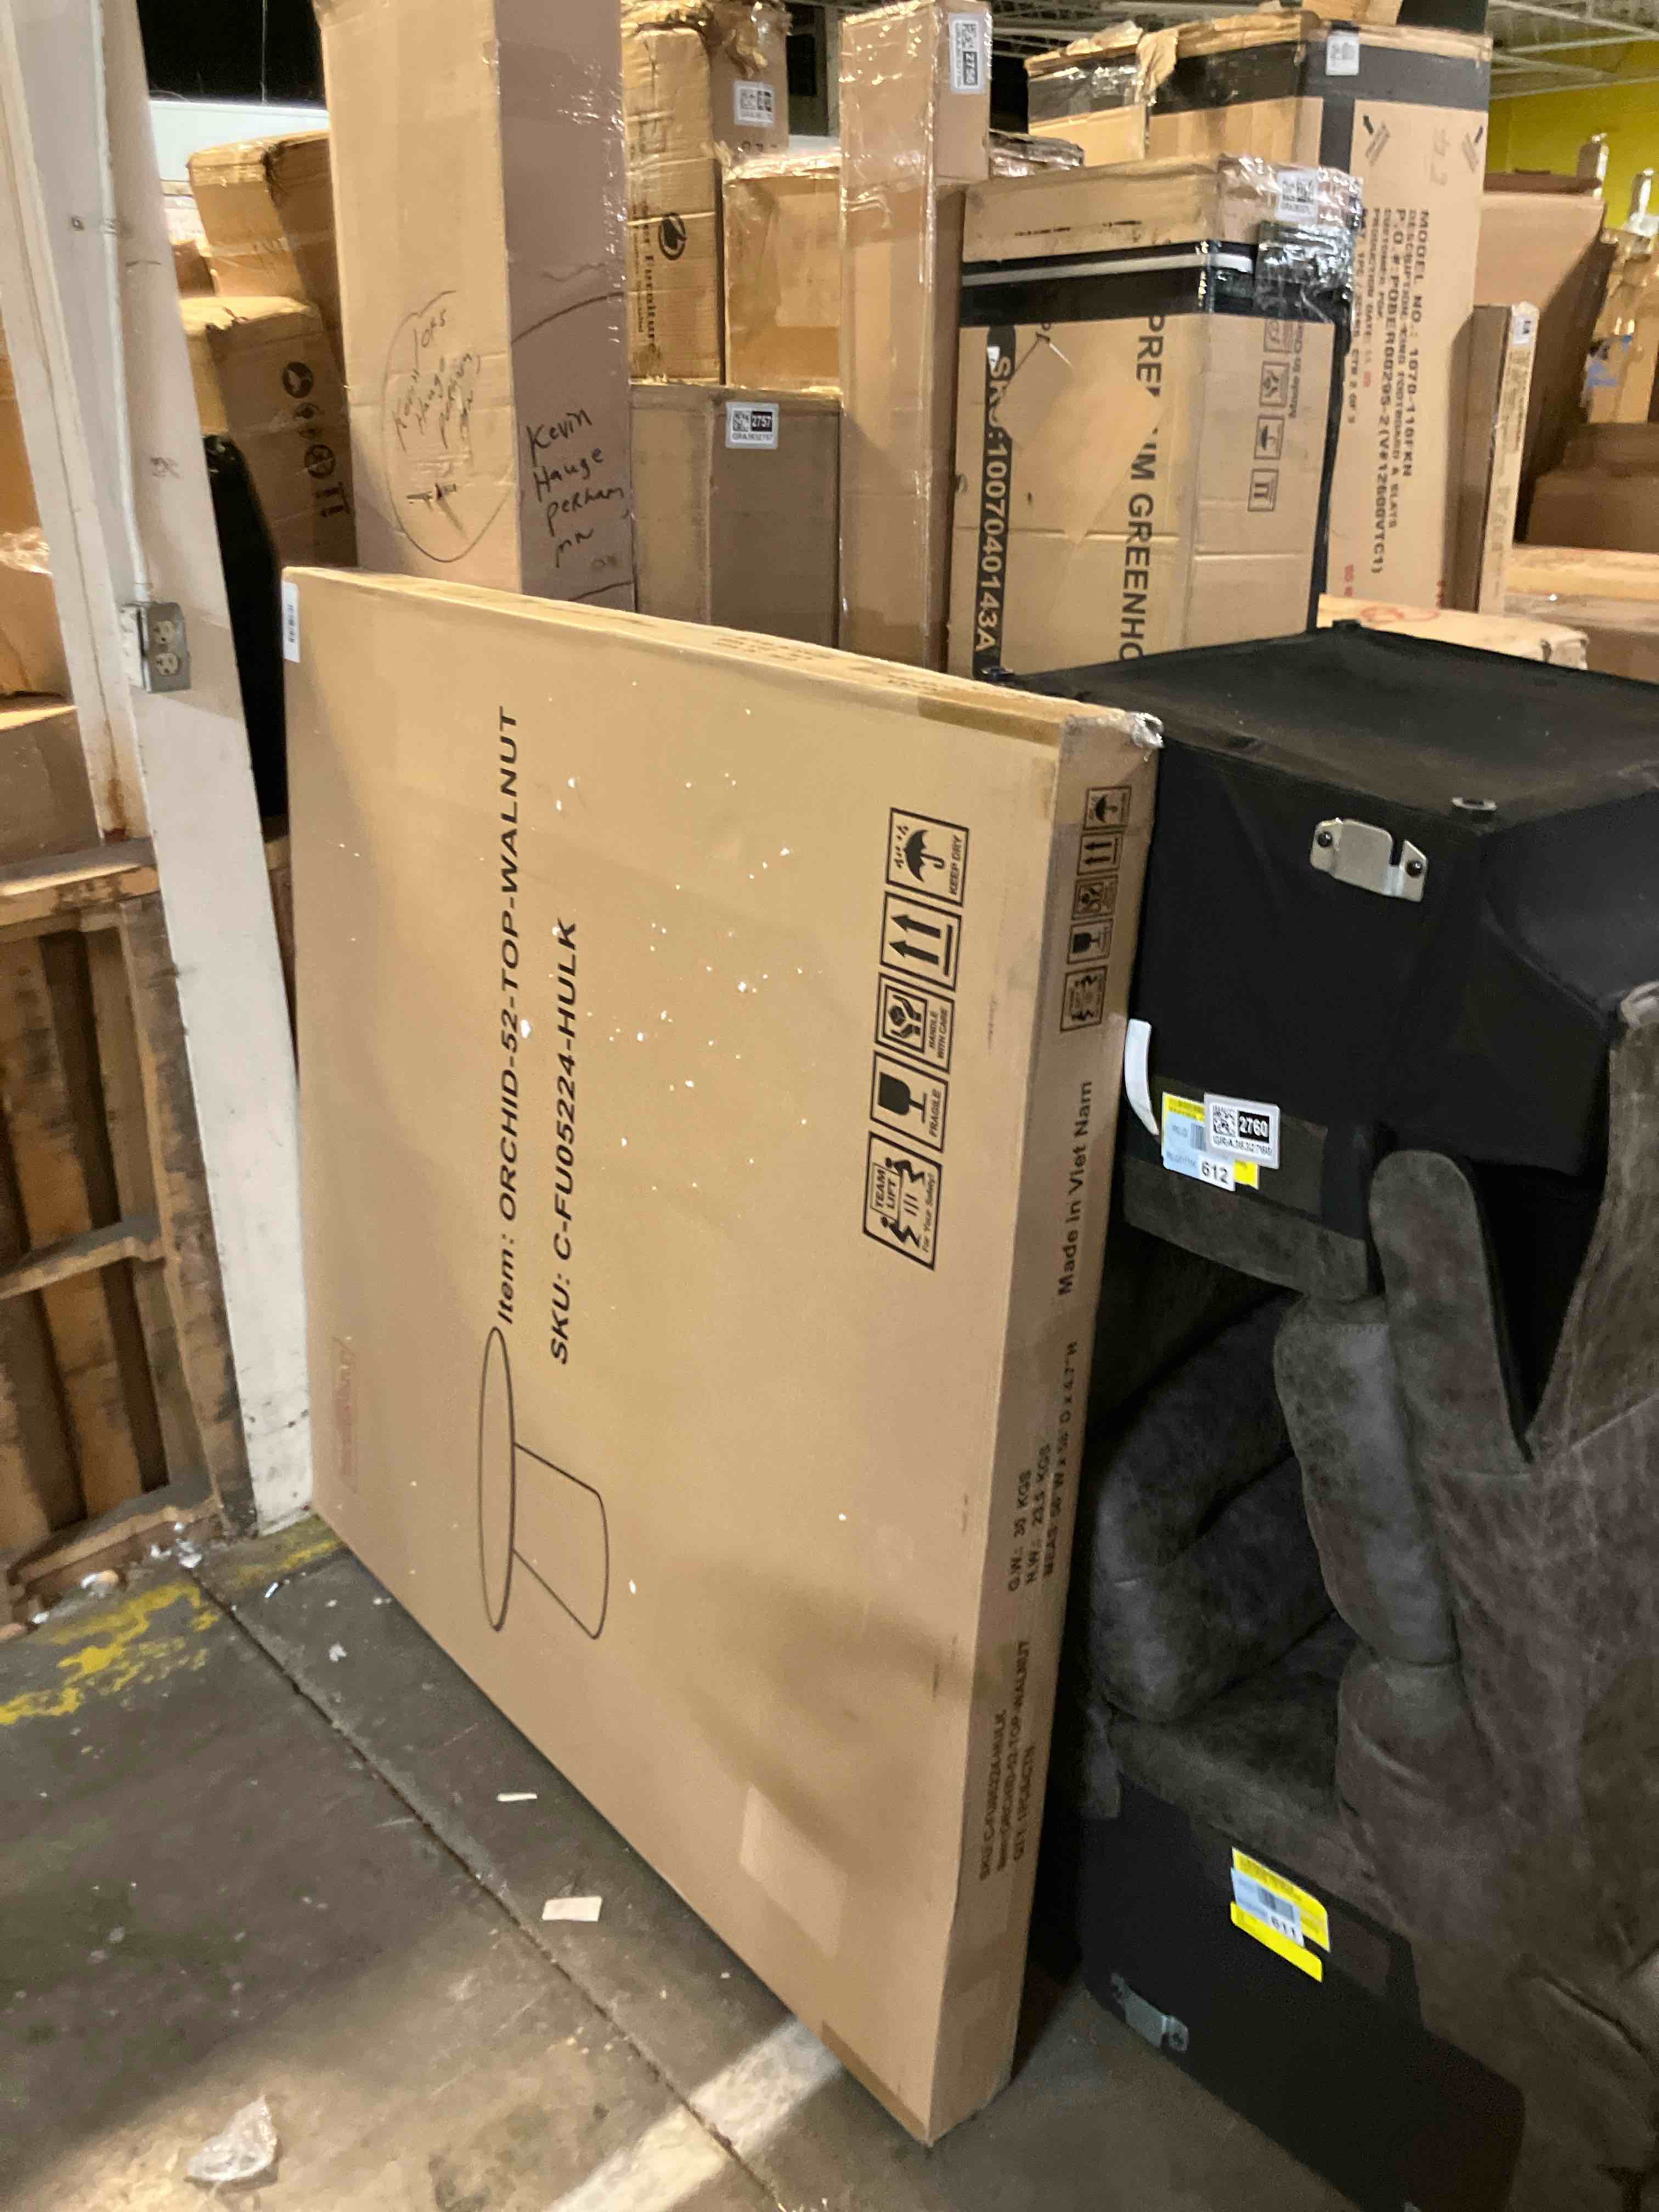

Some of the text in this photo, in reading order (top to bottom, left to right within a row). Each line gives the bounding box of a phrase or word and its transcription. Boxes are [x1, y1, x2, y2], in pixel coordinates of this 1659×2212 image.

[1414, 210, 1429, 284] MODEL
[526, 409, 592, 467] Kevin
[752, 415, 772, 428] 2757
[533, 448, 603, 503] Hauge
[949, 833, 963, 896] KEEP DRY
[496, 706, 520, 1325] Item: ORCHID-52-TOP-WALNUT
[928, 1011, 939, 1049] HANDLE
[937, 1008, 949, 1059] WITH CARE
[929, 1088, 943, 1138] FRAGILE
[1074, 1080, 1093, 1138] Nam
[1239, 1111, 1269, 1141] 2760
[550, 917, 577, 1365] SKU: C-FU05224-HULK
[874, 1169, 887, 1208] TEAM
[885, 1178, 896, 1210] LIFT
[1068, 1144, 1087, 1196] Viet
[1201, 1160, 1229, 1184] 612
[1057, 1229, 1079, 1296] Made
